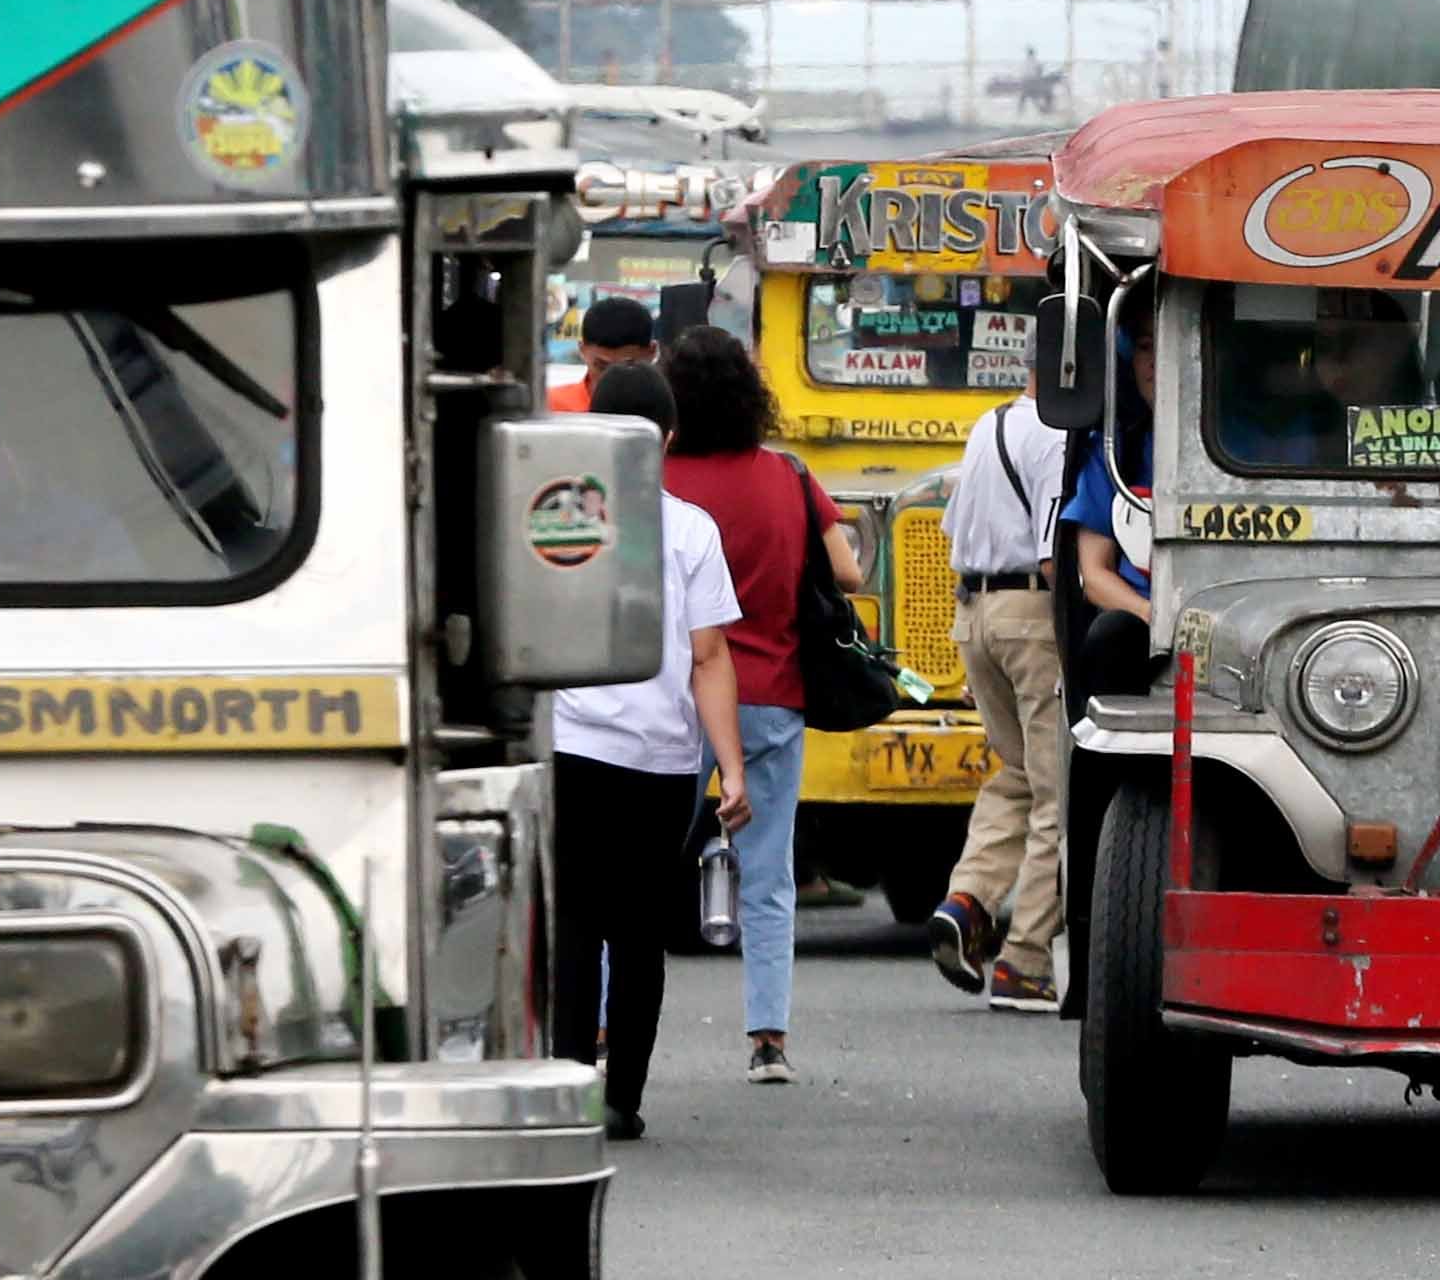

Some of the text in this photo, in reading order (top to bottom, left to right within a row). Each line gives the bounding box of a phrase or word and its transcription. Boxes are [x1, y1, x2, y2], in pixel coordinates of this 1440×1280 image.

[845, 352, 924, 371] KALAW
[851, 419, 958, 437] PHILCOA
[1183, 504, 1302, 541] LAGRO
[882, 738, 935, 774] TVX
